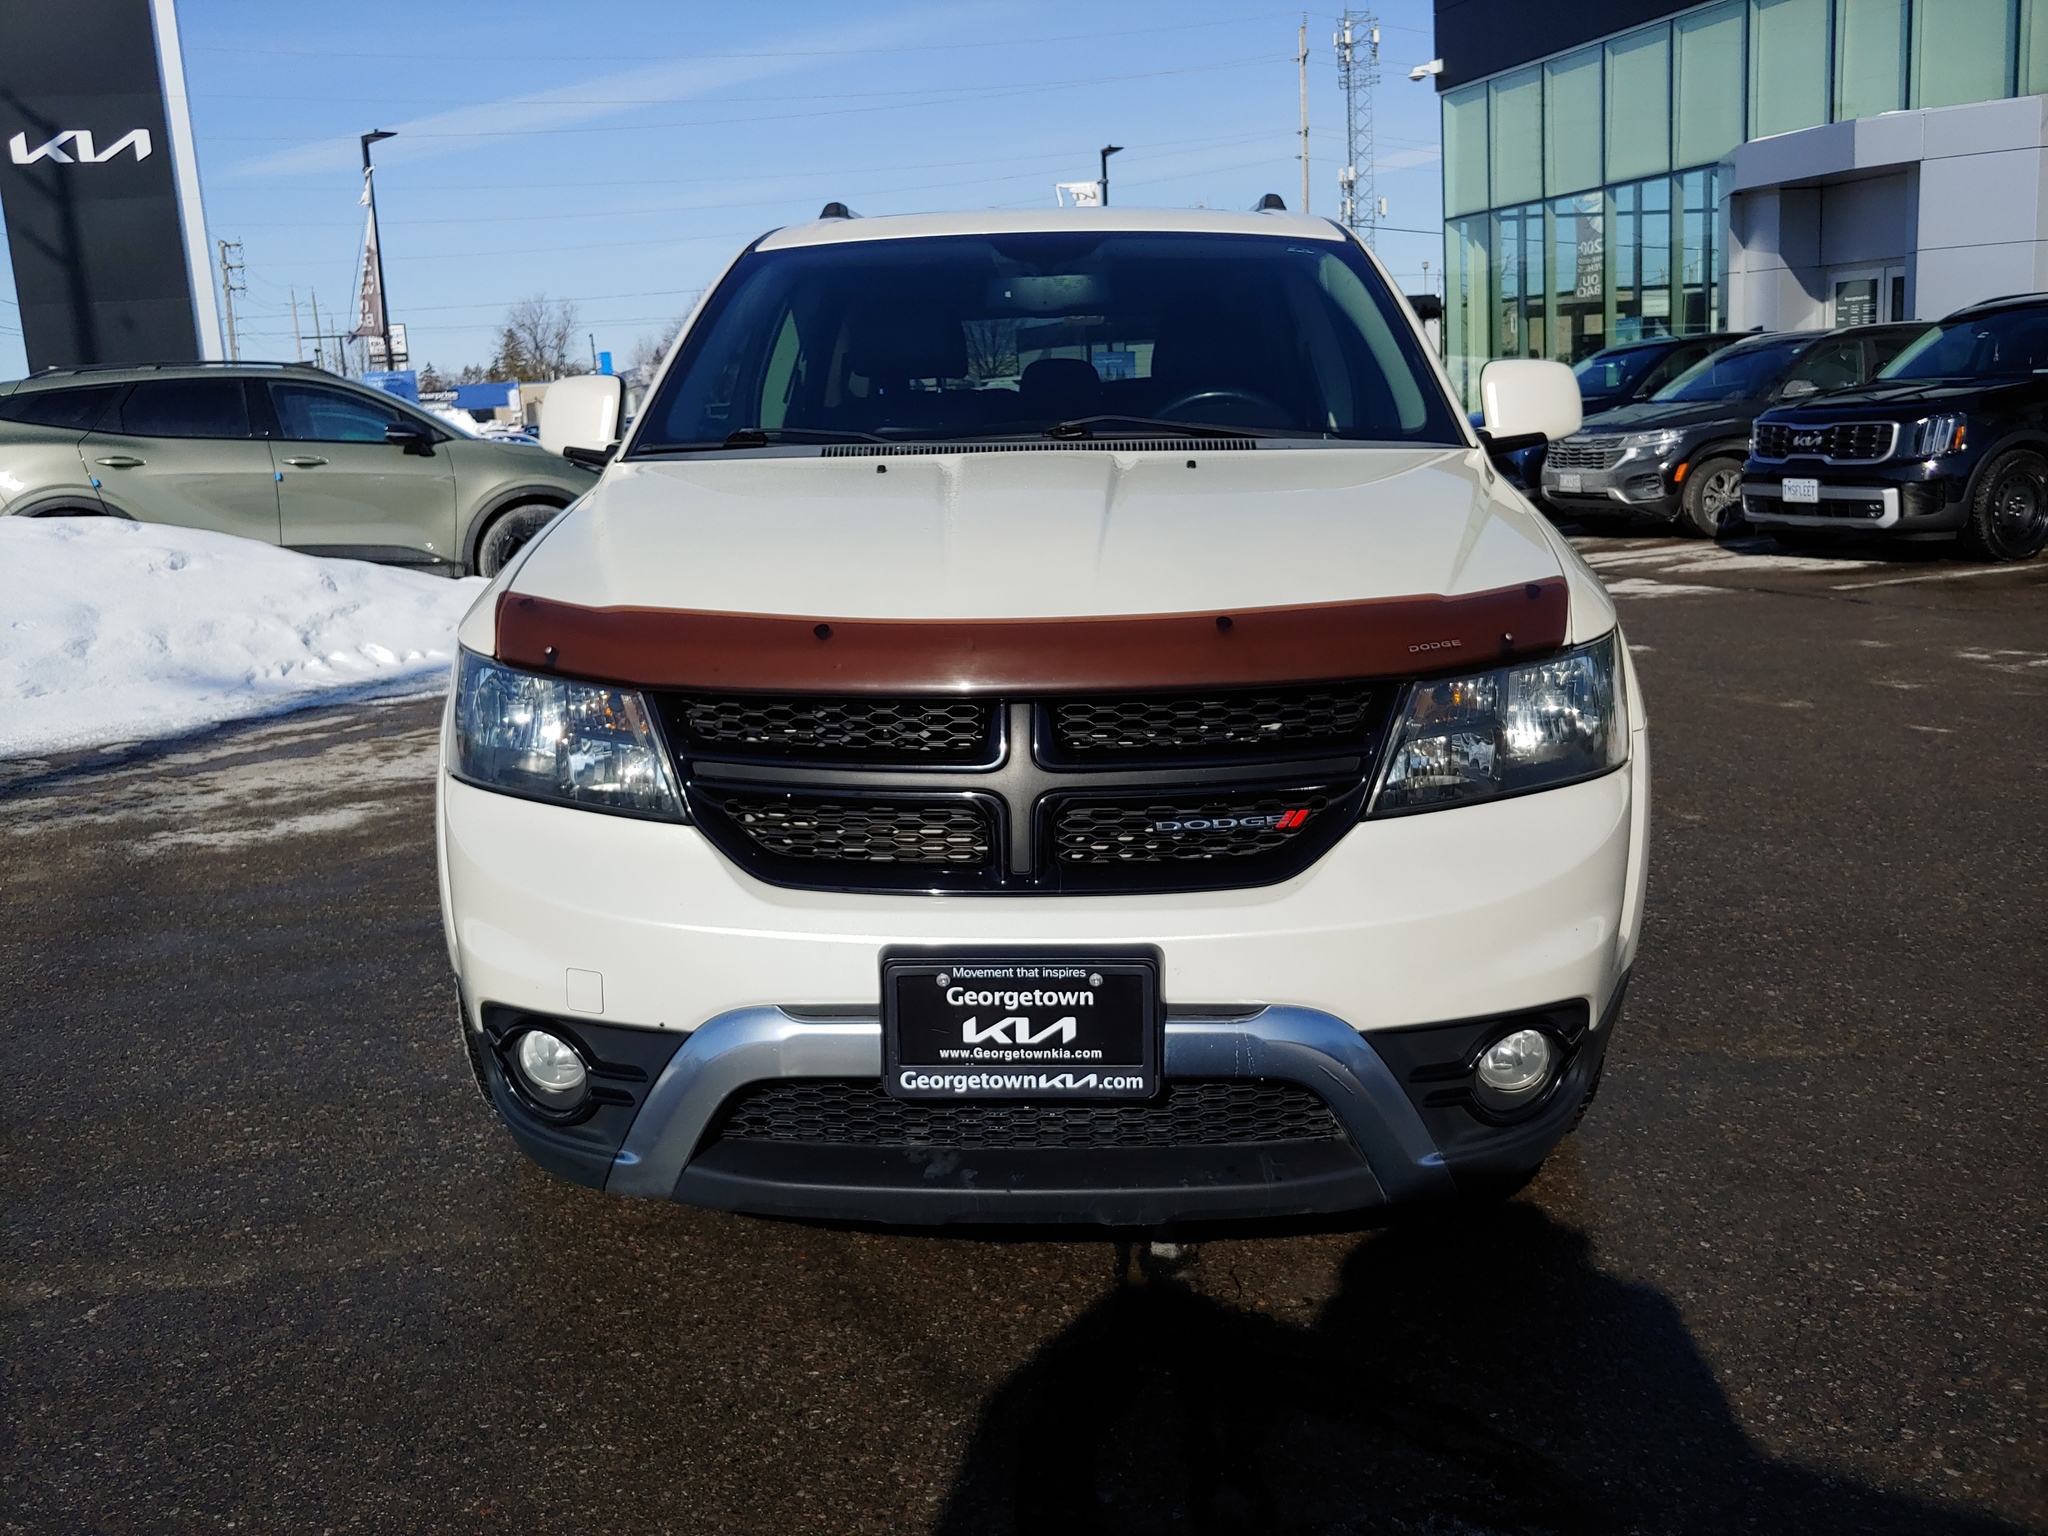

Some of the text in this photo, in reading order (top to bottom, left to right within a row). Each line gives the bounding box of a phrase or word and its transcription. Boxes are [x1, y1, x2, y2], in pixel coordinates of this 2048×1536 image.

[10, 128, 152, 164] KIA
[1408, 640, 1462, 653] DODGE
[1155, 814, 1289, 831] DODGE
[952, 967, 1087, 979] Movement that inspires
[946, 986, 1094, 1010] Georgetown
[962, 1015, 1077, 1044] KIA
[939, 1047, 1102, 1060] www.Georgetownkia.com
